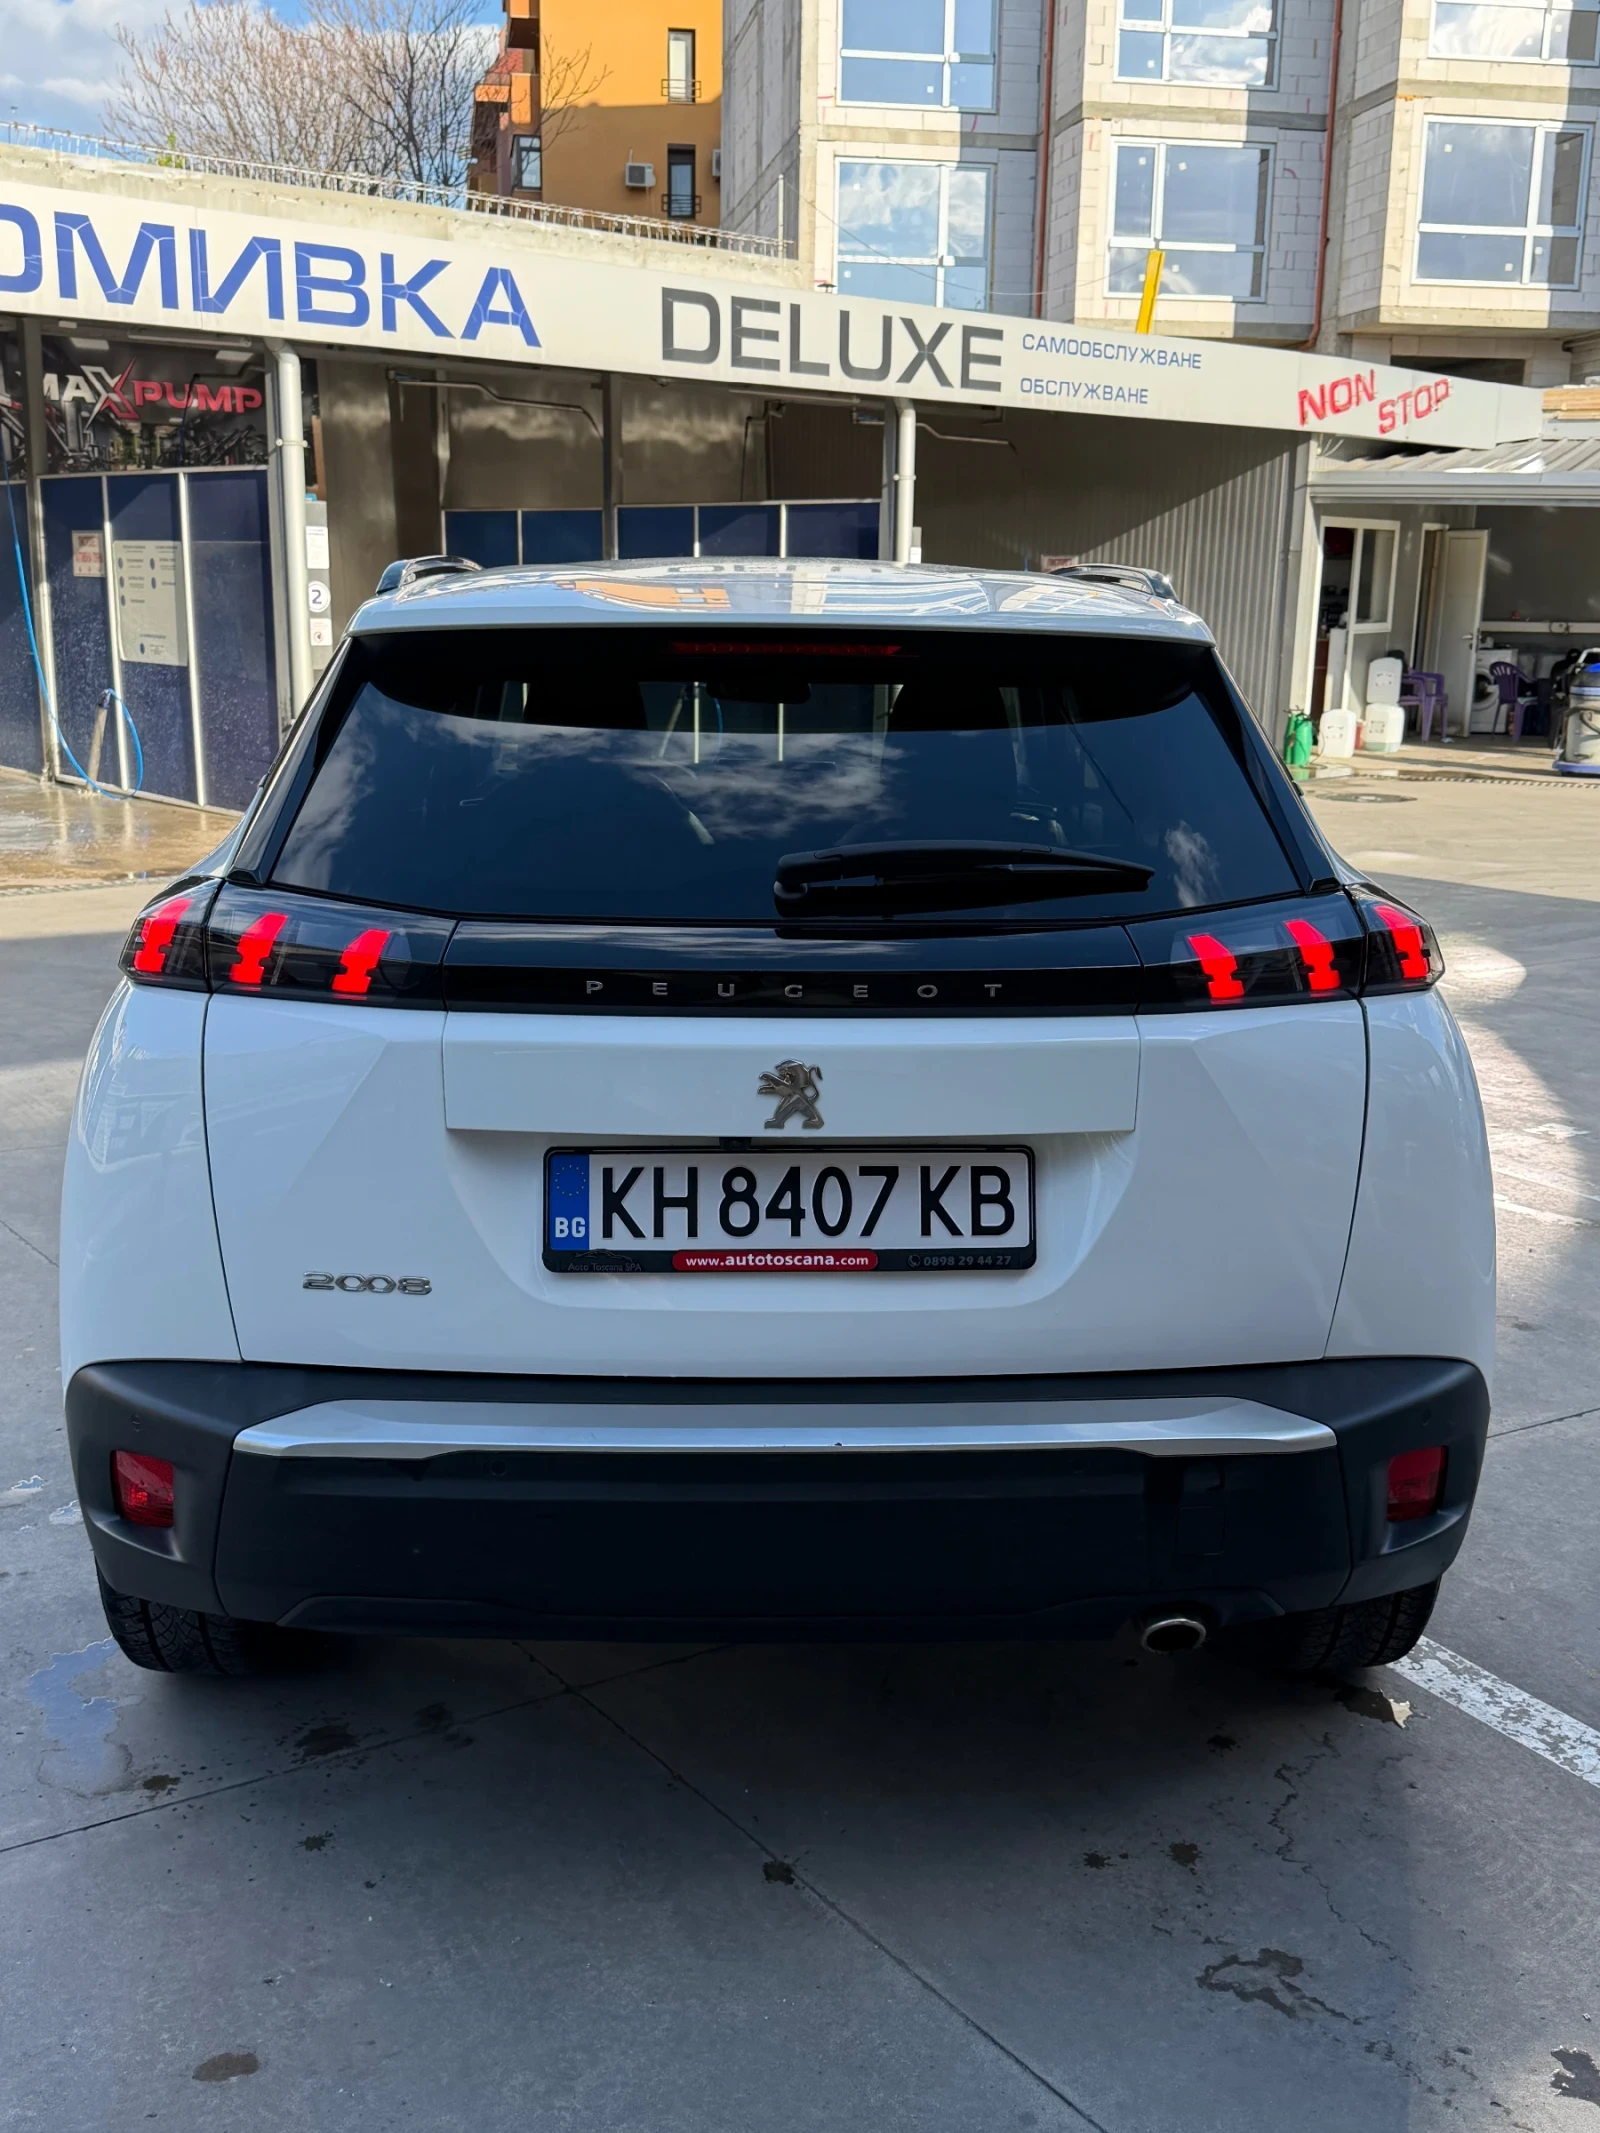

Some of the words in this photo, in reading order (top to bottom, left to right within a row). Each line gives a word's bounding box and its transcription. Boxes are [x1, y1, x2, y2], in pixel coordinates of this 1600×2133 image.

[661, 286, 1005, 393] DELUXE
[1022, 333, 1202, 370] САМООБСЛУЖВАНЕ
[1020, 377, 1149, 404] ОБСЛУЖВАНЕ
[1297, 368, 1375, 427] NON
[1378, 378, 1451, 435] STOP
[311, 589, 323, 605] 2
[585, 980, 1003, 999] PEUGEOT
[601, 1165, 699, 1239] KH
[718, 1166, 900, 1238] 8407
[918, 1165, 1016, 1237] KB
[554, 1216, 586, 1239] BG
[567, 1262, 589, 1272] Auto
[591, 1262, 624, 1272] Toscana
[685, 1253, 870, 1267] www.autotoscana.com
[958, 1256, 974, 1266] 29
[977, 1256, 993, 1266] 44
[996, 1255, 1012, 1265] 27
[302, 1270, 433, 1296] 2008
